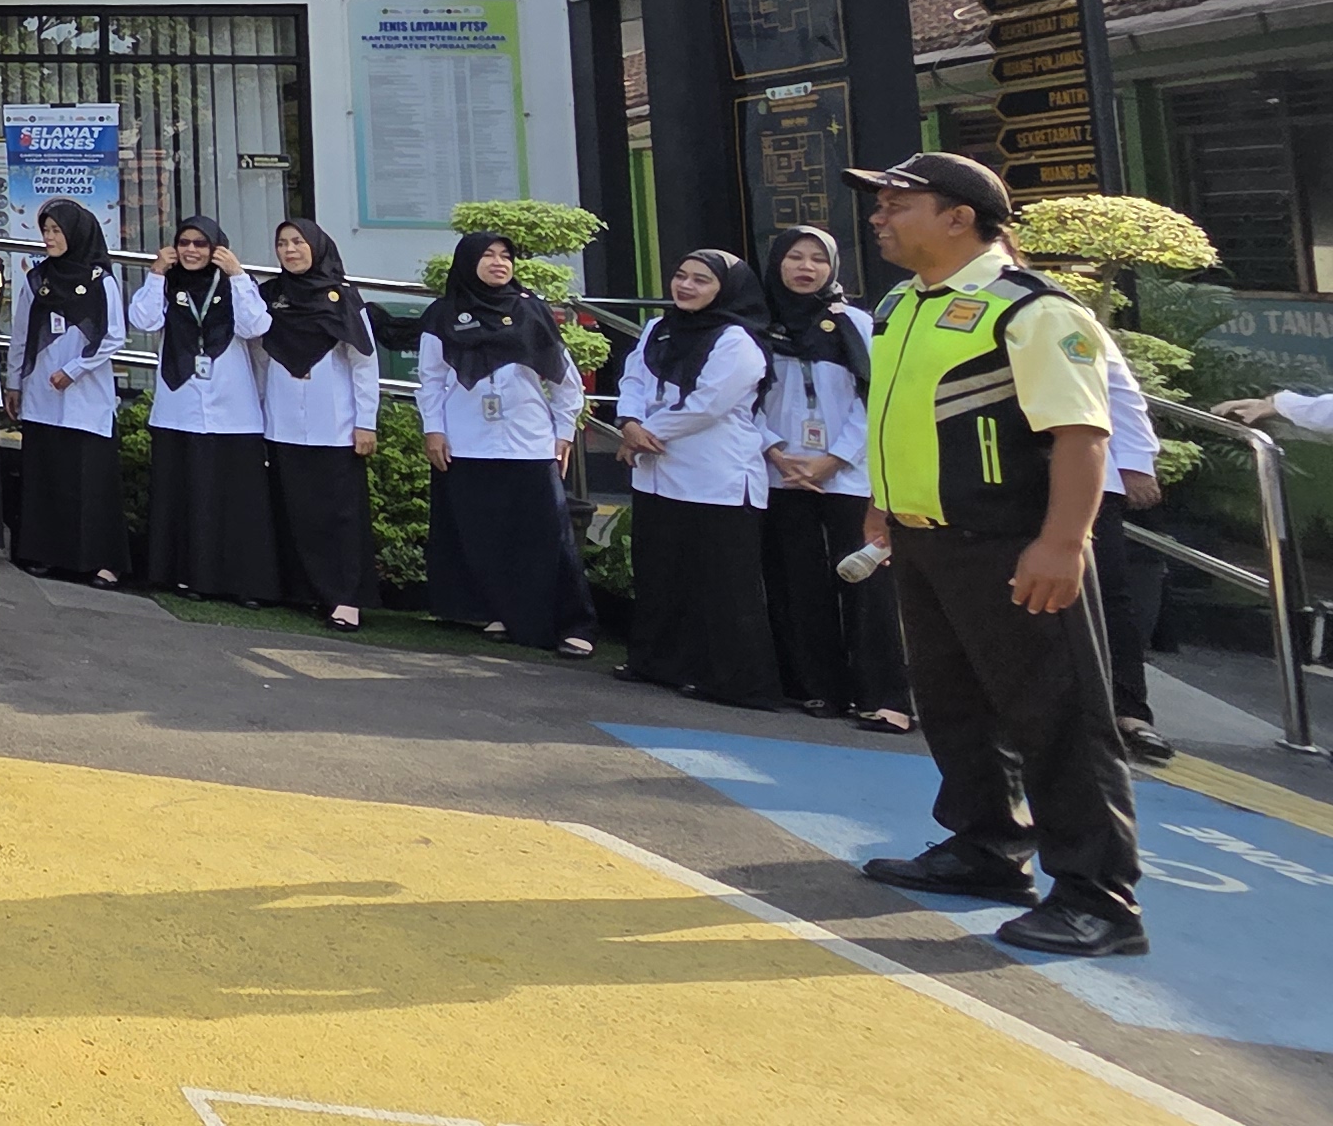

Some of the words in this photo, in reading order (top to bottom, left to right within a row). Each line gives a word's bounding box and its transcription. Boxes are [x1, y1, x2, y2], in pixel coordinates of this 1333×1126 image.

[378, 21, 408, 33] JENIS
[410, 21, 458, 33] LAYANAN
[460, 21, 488, 33] PTSP
[21, 127, 103, 139] SELAMAT
[29, 138, 95, 150] SUKSES
[40, 168, 87, 176] MERAIH
[34, 177, 93, 185] PREDIKAT
